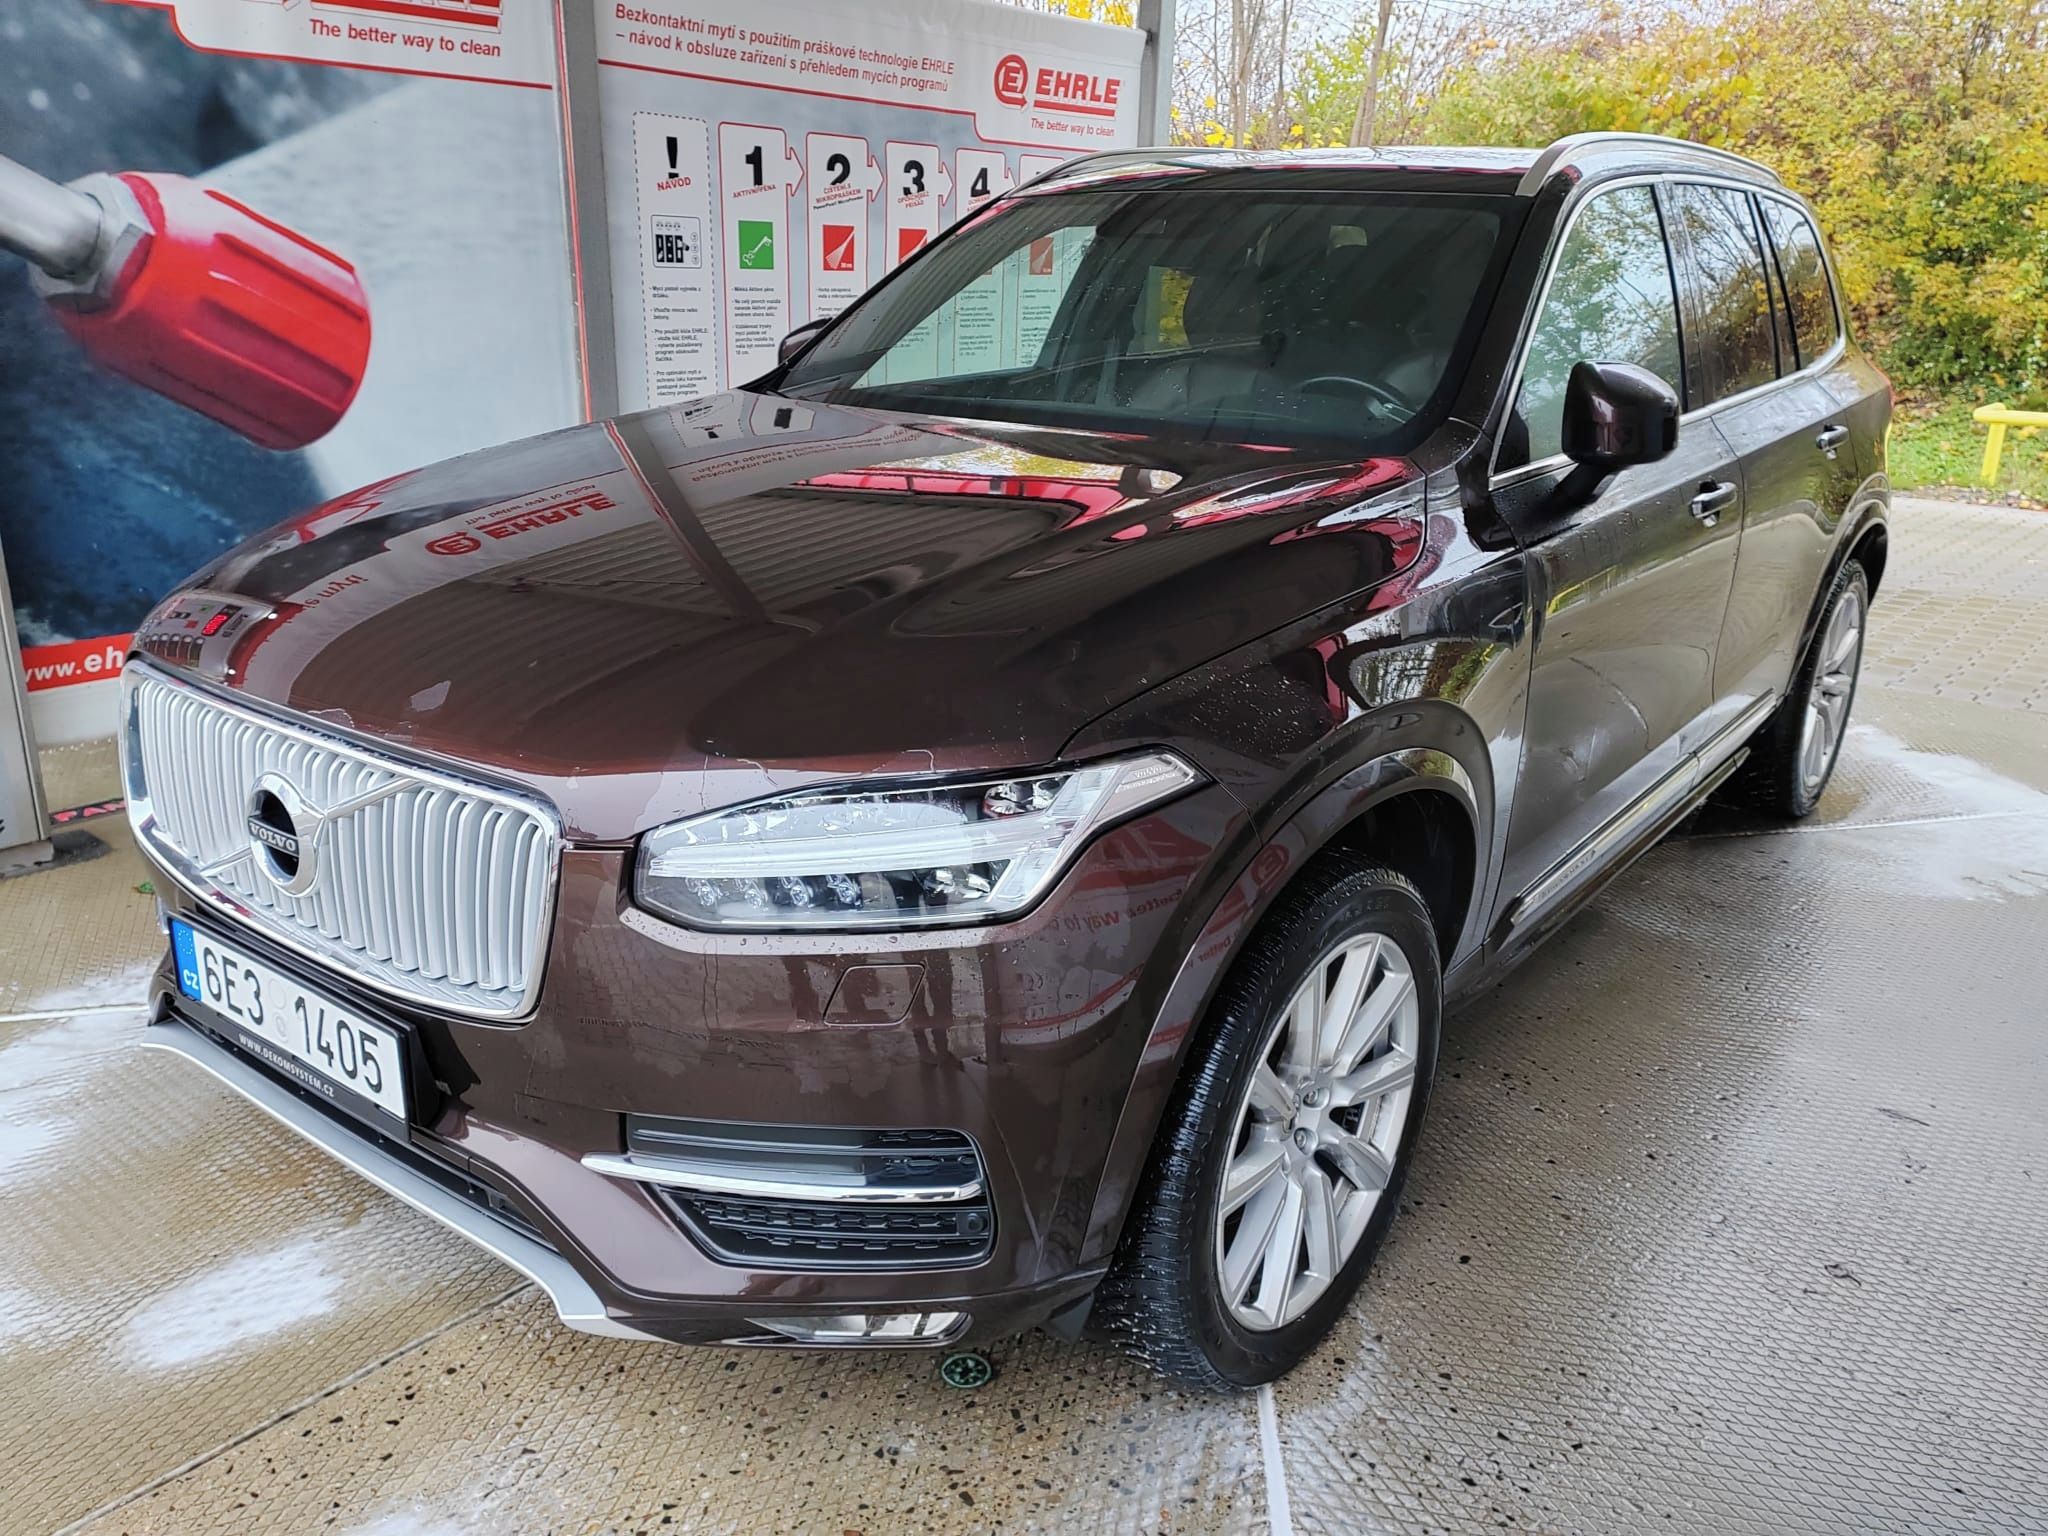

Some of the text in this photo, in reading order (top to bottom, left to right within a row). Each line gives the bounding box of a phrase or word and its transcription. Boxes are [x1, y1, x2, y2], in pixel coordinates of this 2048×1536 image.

[310, 18, 501, 57] The better way to clean
[615, 3, 955, 75] Bezkontaktní mytí s použitím práškové technologie EHRLE
[629, 30, 671, 49] návod
[675, 38, 683, 51] k
[686, 40, 737, 60] obsluze
[739, 49, 787, 68] zařízení
[789, 58, 797, 70] s
[799, 59, 859, 79] přehledem
[862, 69, 898, 85] mycích
[900, 75, 949, 92] programů
[1036, 68, 1121, 104] EHRLE
[1031, 117, 1115, 137] The better way to clean
[745, 146, 763, 186] 1
[826, 153, 850, 185] 2
[903, 160, 925, 196] 3
[970, 167, 990, 197] 4
[249, 823, 296, 851] VOLVO
[183, 968, 199, 990] CZ
[203, 946, 382, 1094] 6E3 1405
[238, 1033, 335, 1098] WWW.DEKOMSYSTEM.CZ
